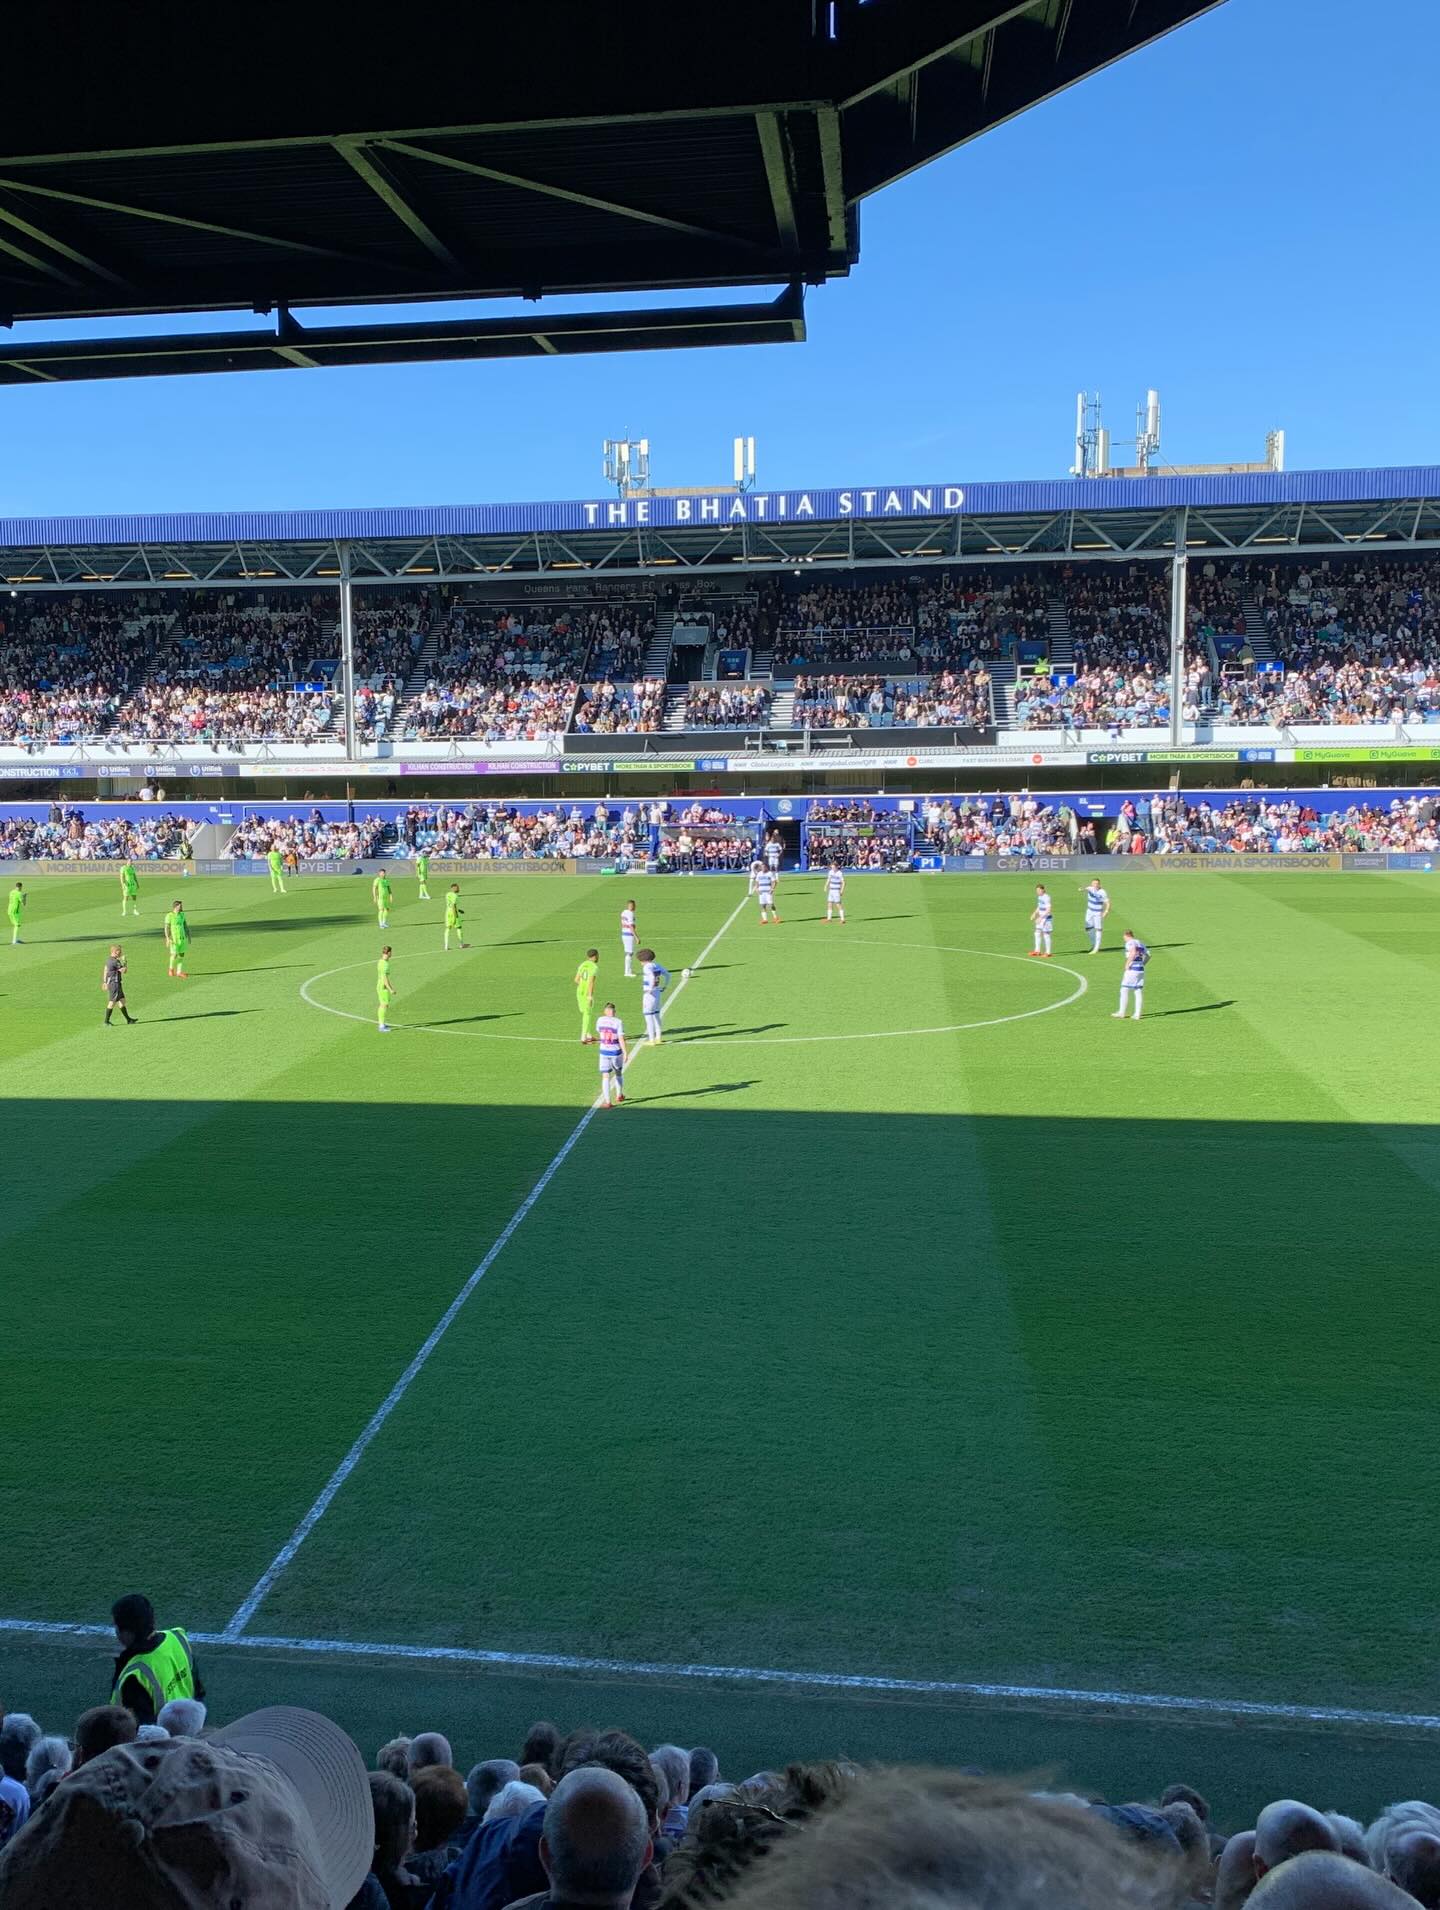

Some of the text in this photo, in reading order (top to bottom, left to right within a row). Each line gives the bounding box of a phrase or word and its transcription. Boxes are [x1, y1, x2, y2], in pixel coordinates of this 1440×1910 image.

[584, 488, 964, 524] THE BHATIA STAND
[524, 584, 560, 593] Queens
[566, 584, 589, 592] Park
[595, 582, 636, 592] Rangers
[697, 579, 715, 588] Box
[1266, 662, 1274, 671] F
[305, 682, 313, 691] C
[1059, 676, 1067, 687] E
[427, 863, 454, 872] ORE
[455, 863, 482, 872] THAN
[493, 862, 567, 872] SPORTSBOOK
[921, 858, 934, 868] P1
[1160, 857, 1331, 868] MORE THAN A SPORTSBOOK
[47, 864, 78, 872] MORE
[79, 864, 105, 872] THAN
